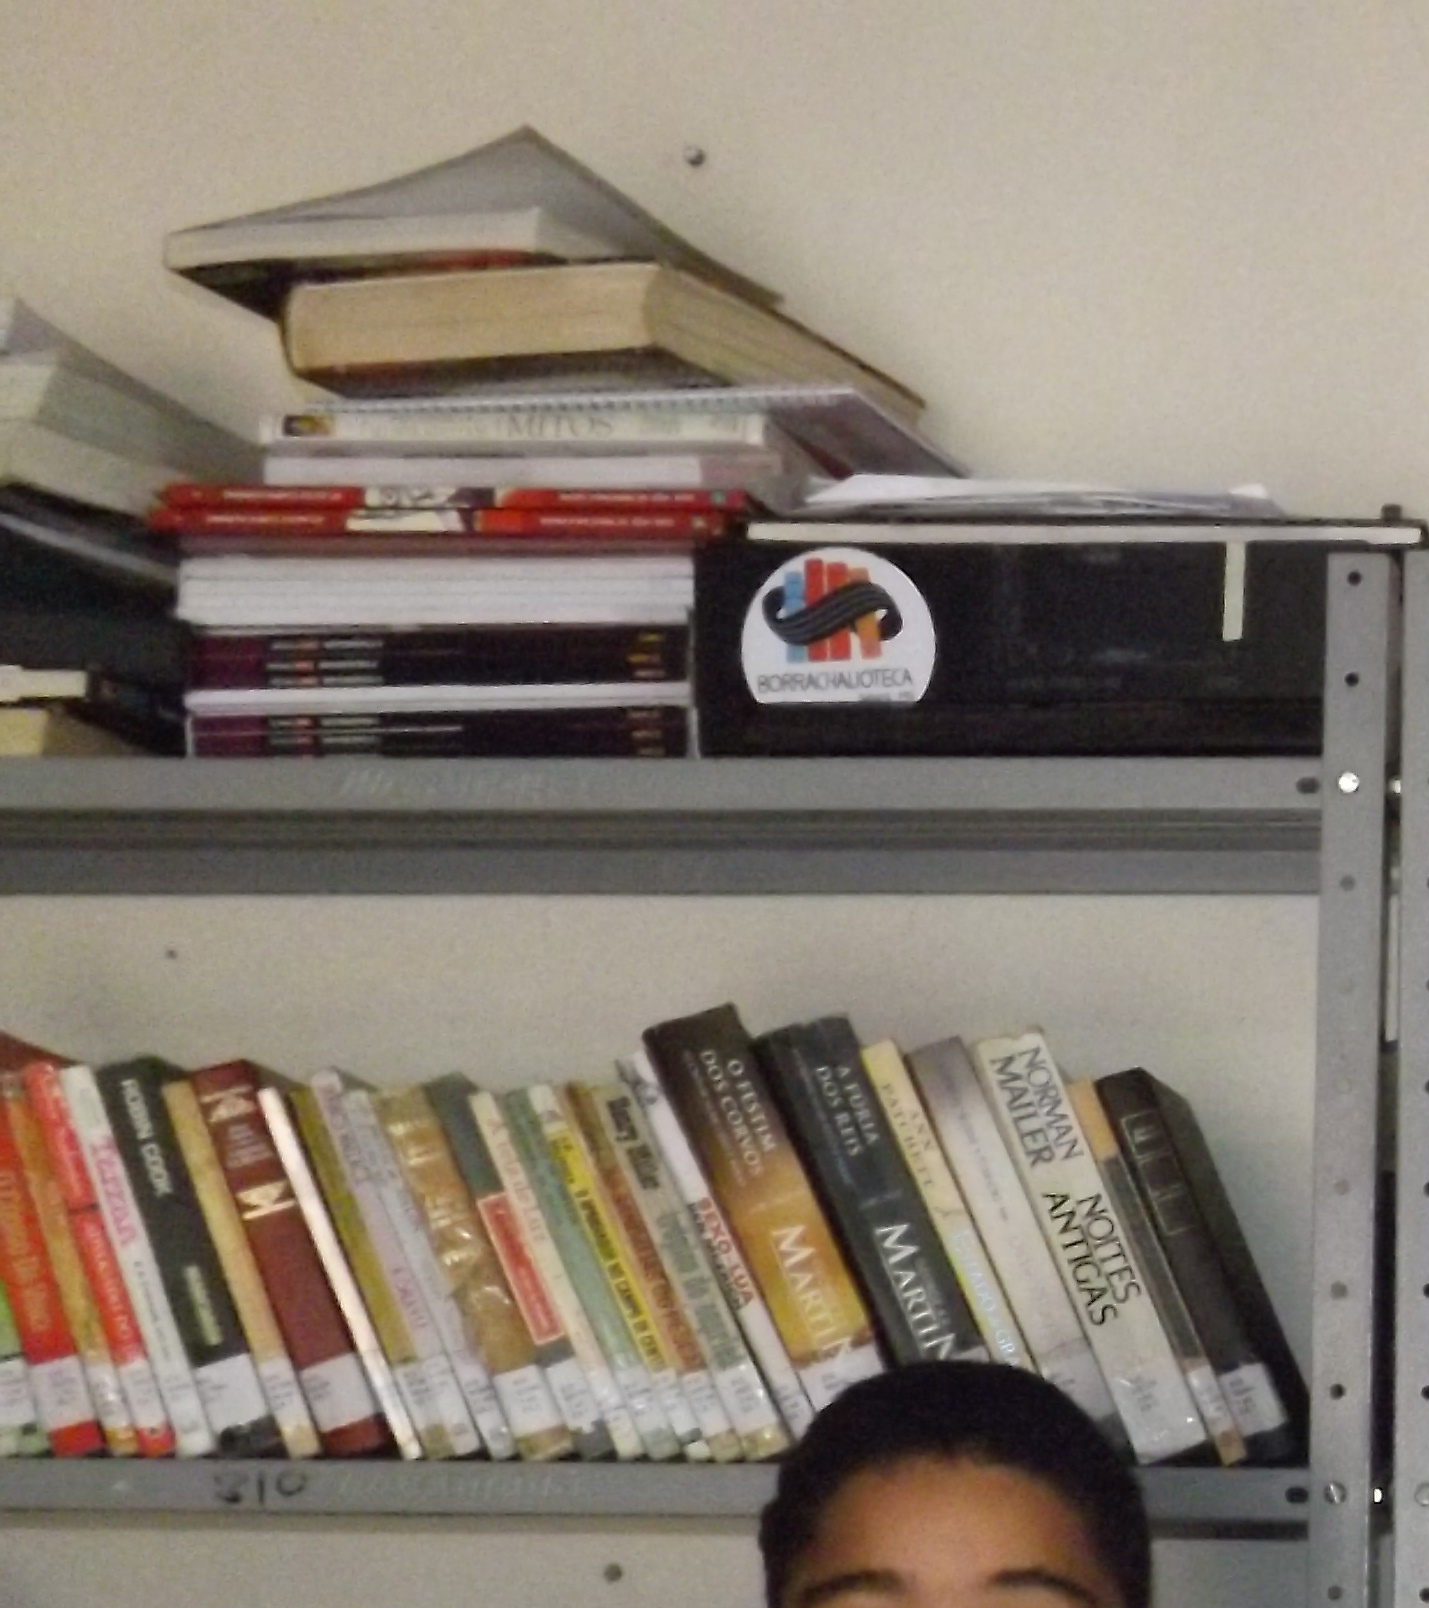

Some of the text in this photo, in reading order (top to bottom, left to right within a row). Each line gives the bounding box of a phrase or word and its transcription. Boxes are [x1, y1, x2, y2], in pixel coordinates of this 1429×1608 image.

[757, 668, 914, 693] BORRACHALIOTECA
[697, 1047, 728, 1094] DOS
[717, 1092, 766, 1181] CORVOS
[734, 1078, 777, 1154] FESTIM
[814, 1063, 865, 1158] DOS REIS
[982, 1049, 1058, 1172] MAILER
[1013, 1042, 1087, 1164] NORMAN
[766, 1217, 862, 1363] MARTIN
[869, 1212, 966, 1365] MARTIN
[1029, 1183, 1128, 1330] ANTIGAS
[1067, 1189, 1149, 1307] NOITES
